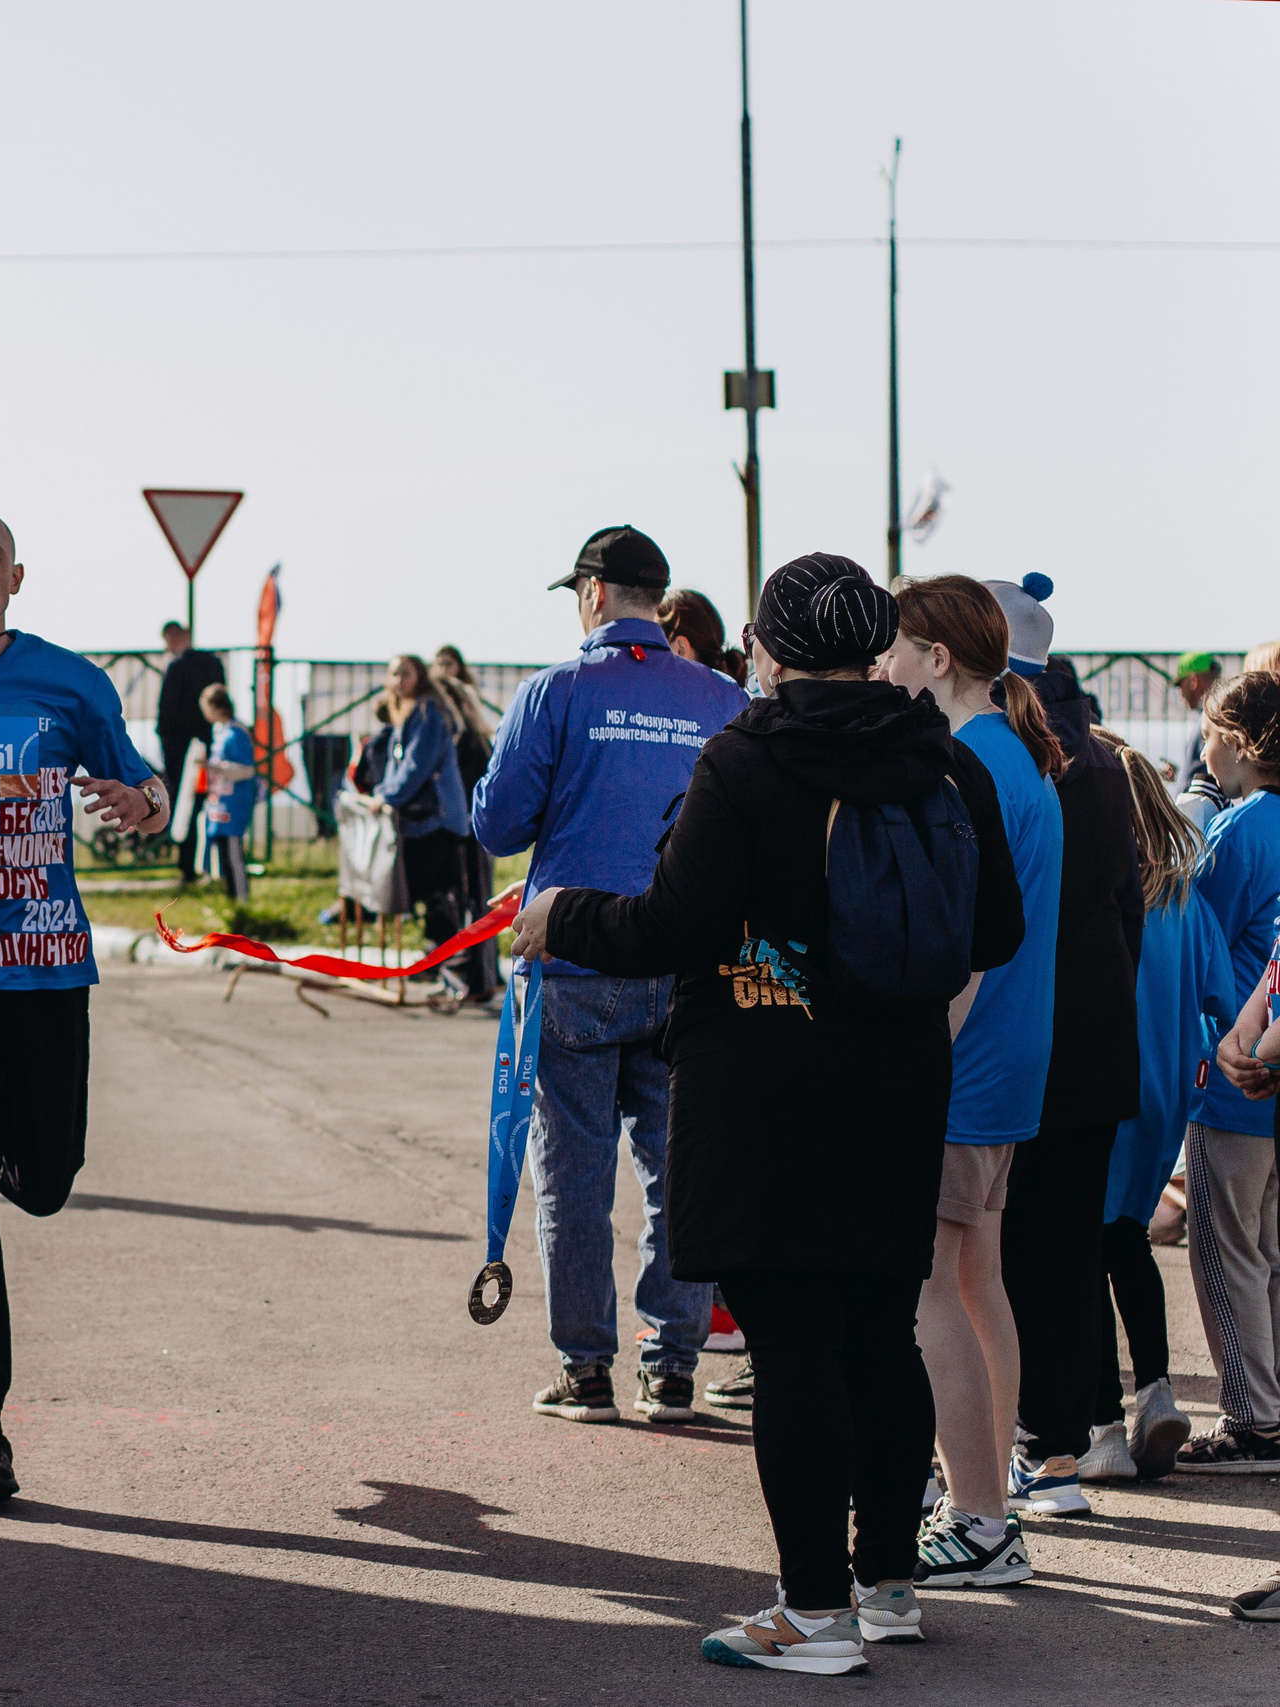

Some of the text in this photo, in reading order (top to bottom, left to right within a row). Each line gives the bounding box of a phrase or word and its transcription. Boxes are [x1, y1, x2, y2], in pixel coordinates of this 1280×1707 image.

[606, 709, 626, 725] МБУ
[589, 726, 668, 743] оздоровительный
[22, 898, 78, 932] 2024
[522, 1054, 533, 1080] ПСБ
[498, 1069, 508, 1094] ПСБ
